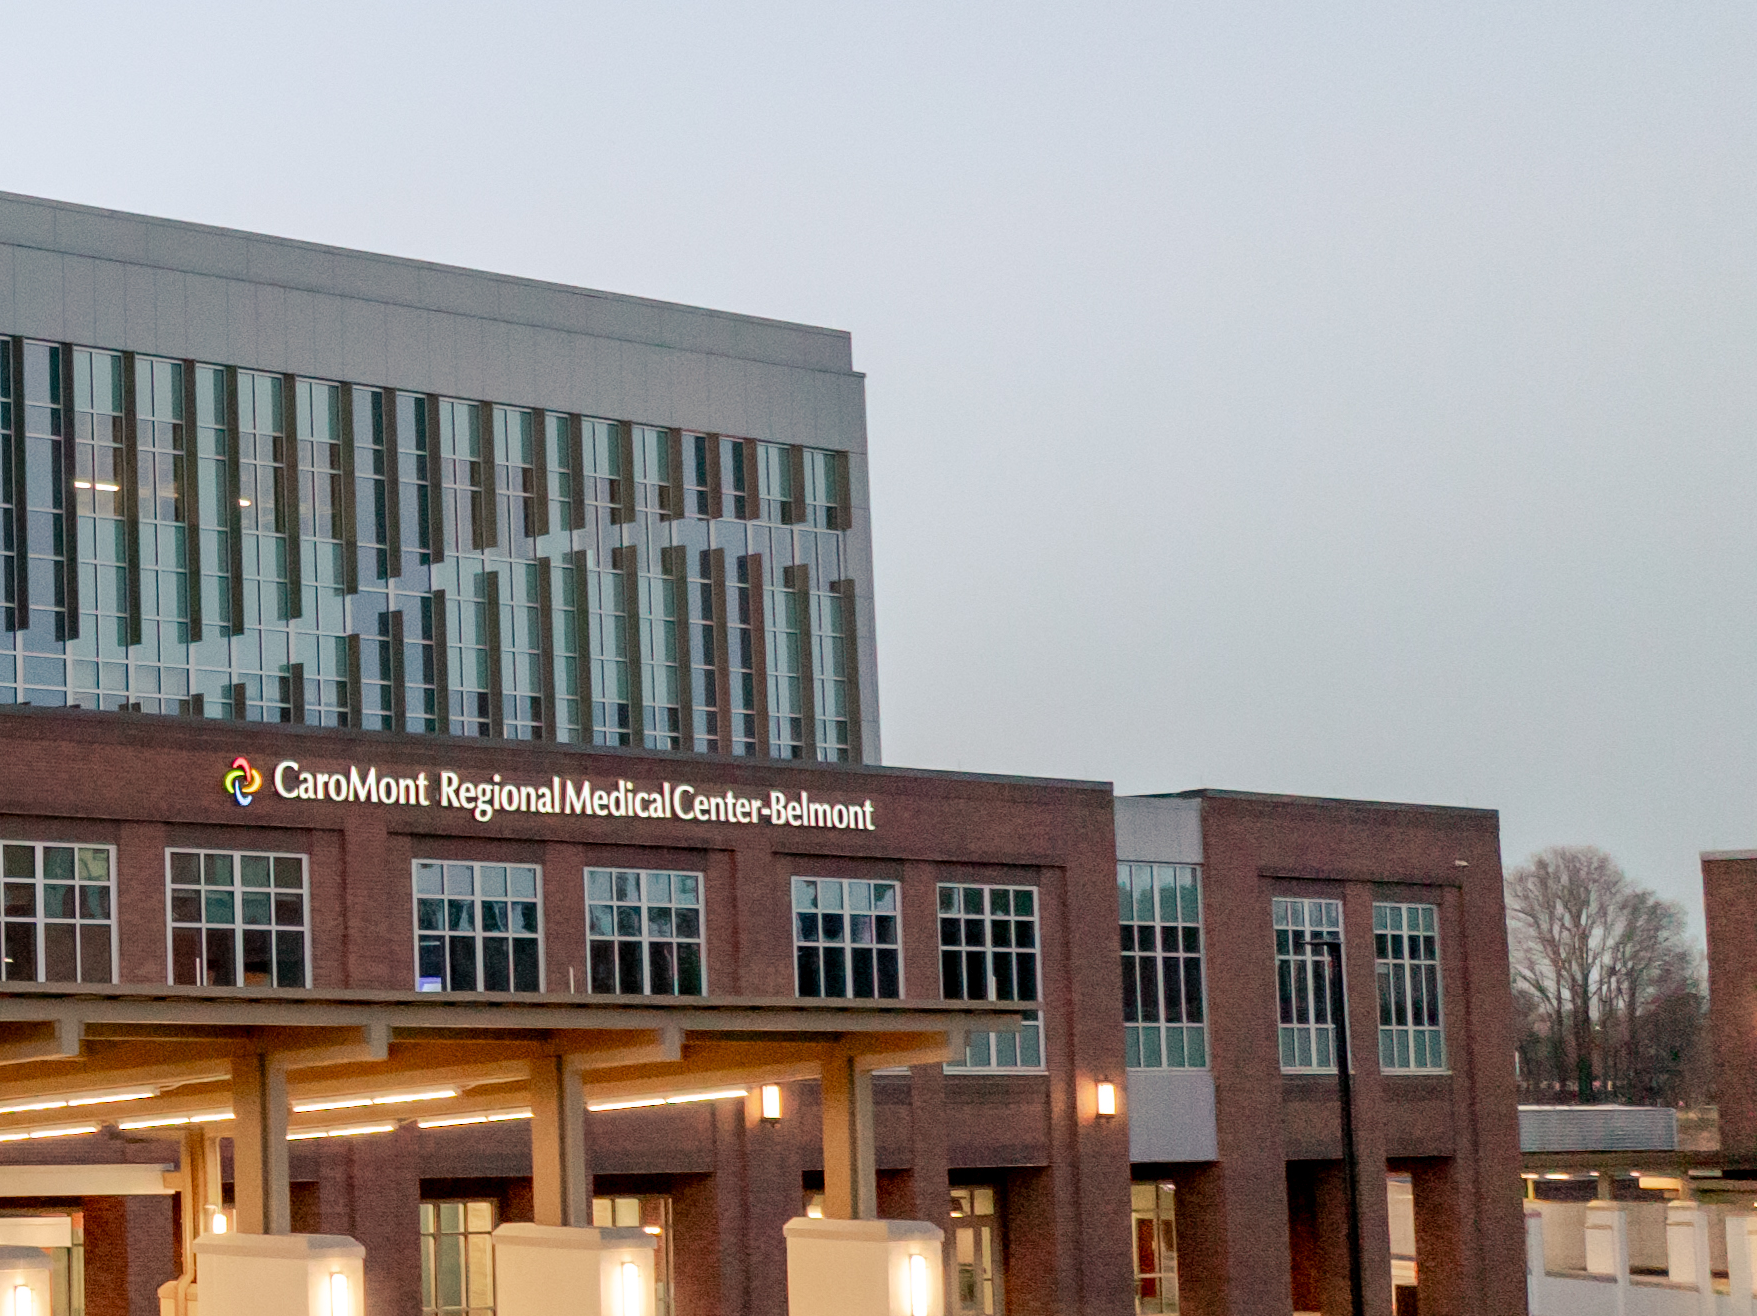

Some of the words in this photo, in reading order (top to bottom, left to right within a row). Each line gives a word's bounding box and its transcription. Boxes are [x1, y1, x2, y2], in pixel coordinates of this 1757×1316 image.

[273, 759, 430, 806] CaroMont
[439, 770, 561, 822] Regional
[564, 779, 672, 818] Medical
[673, 783, 876, 831] Center-Belmont
